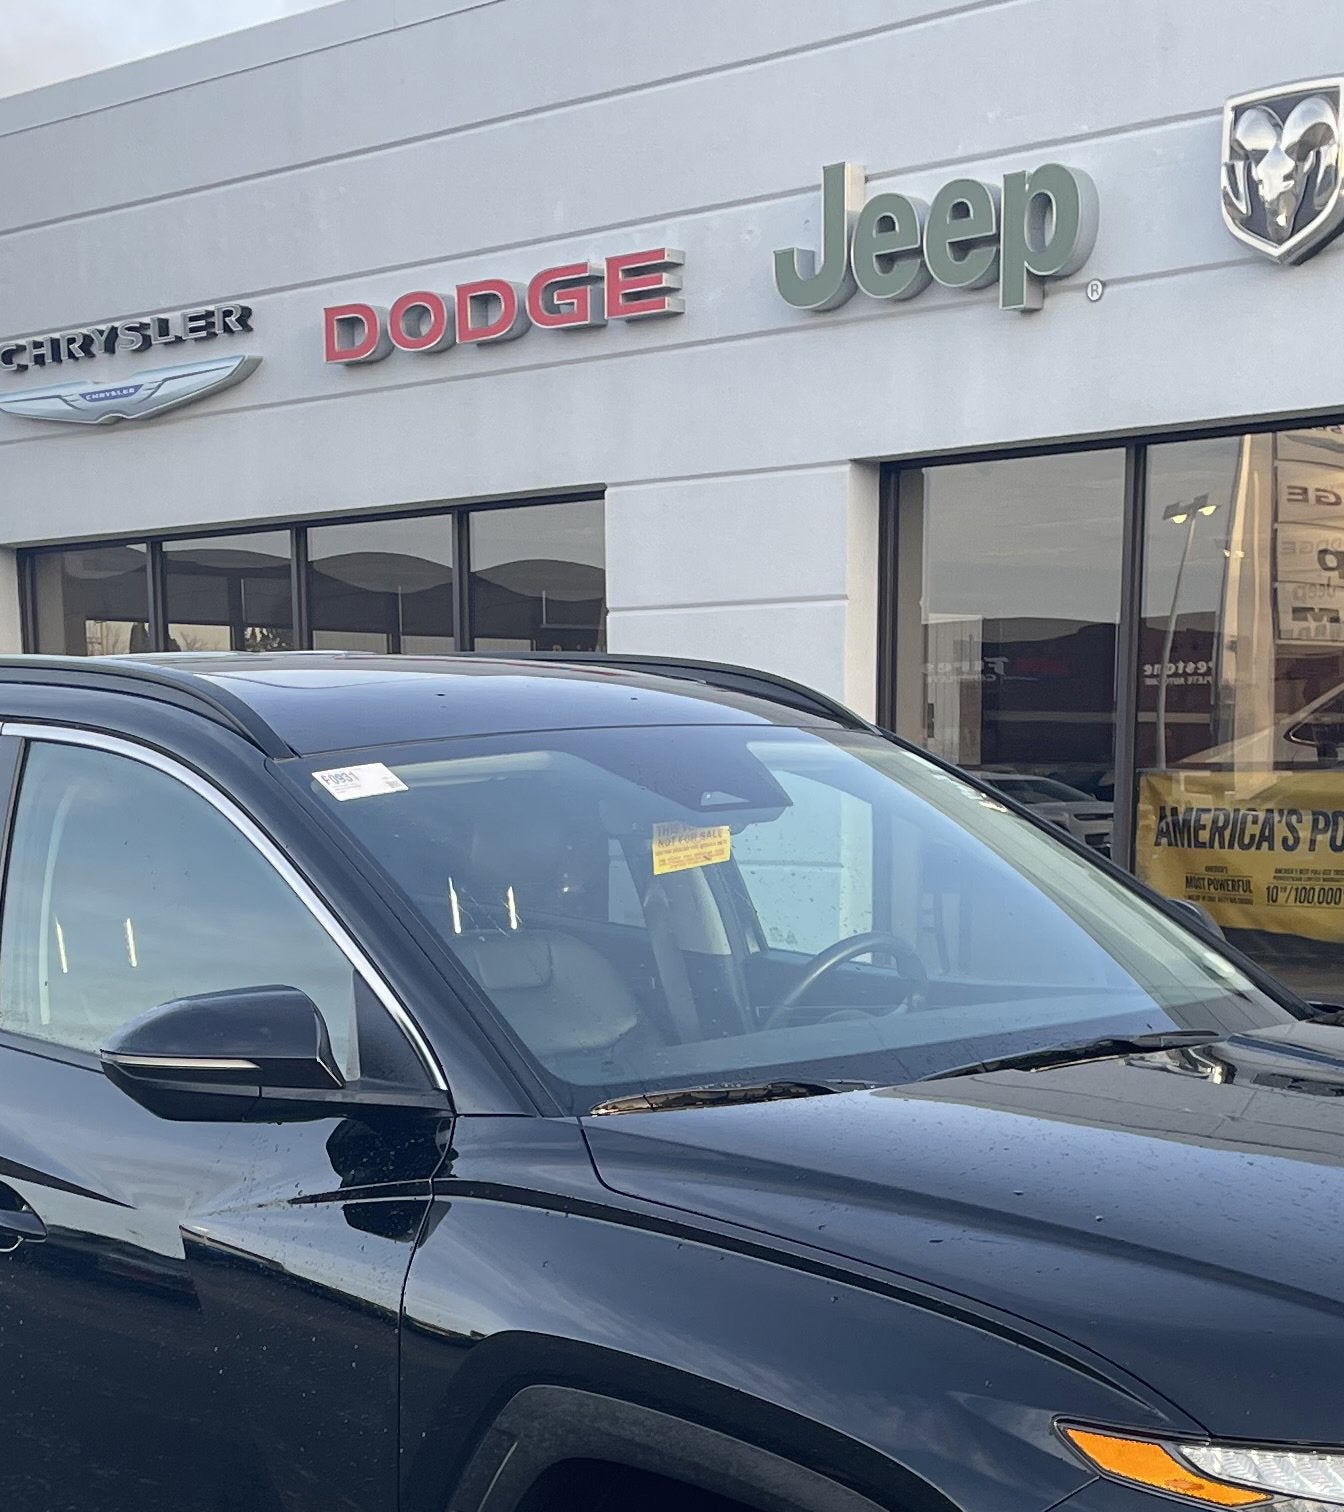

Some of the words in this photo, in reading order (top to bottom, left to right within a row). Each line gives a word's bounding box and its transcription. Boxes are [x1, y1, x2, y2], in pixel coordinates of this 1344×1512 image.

[773, 160, 1093, 311] Jeep
[323, 248, 678, 364] DODGE
[85, 387, 135, 400] CHRYSLER
[1154, 806, 1303, 853] AMERICA'S
[1185, 875, 1207, 890] MOST
[1207, 878, 1253, 894] POWERFUL
